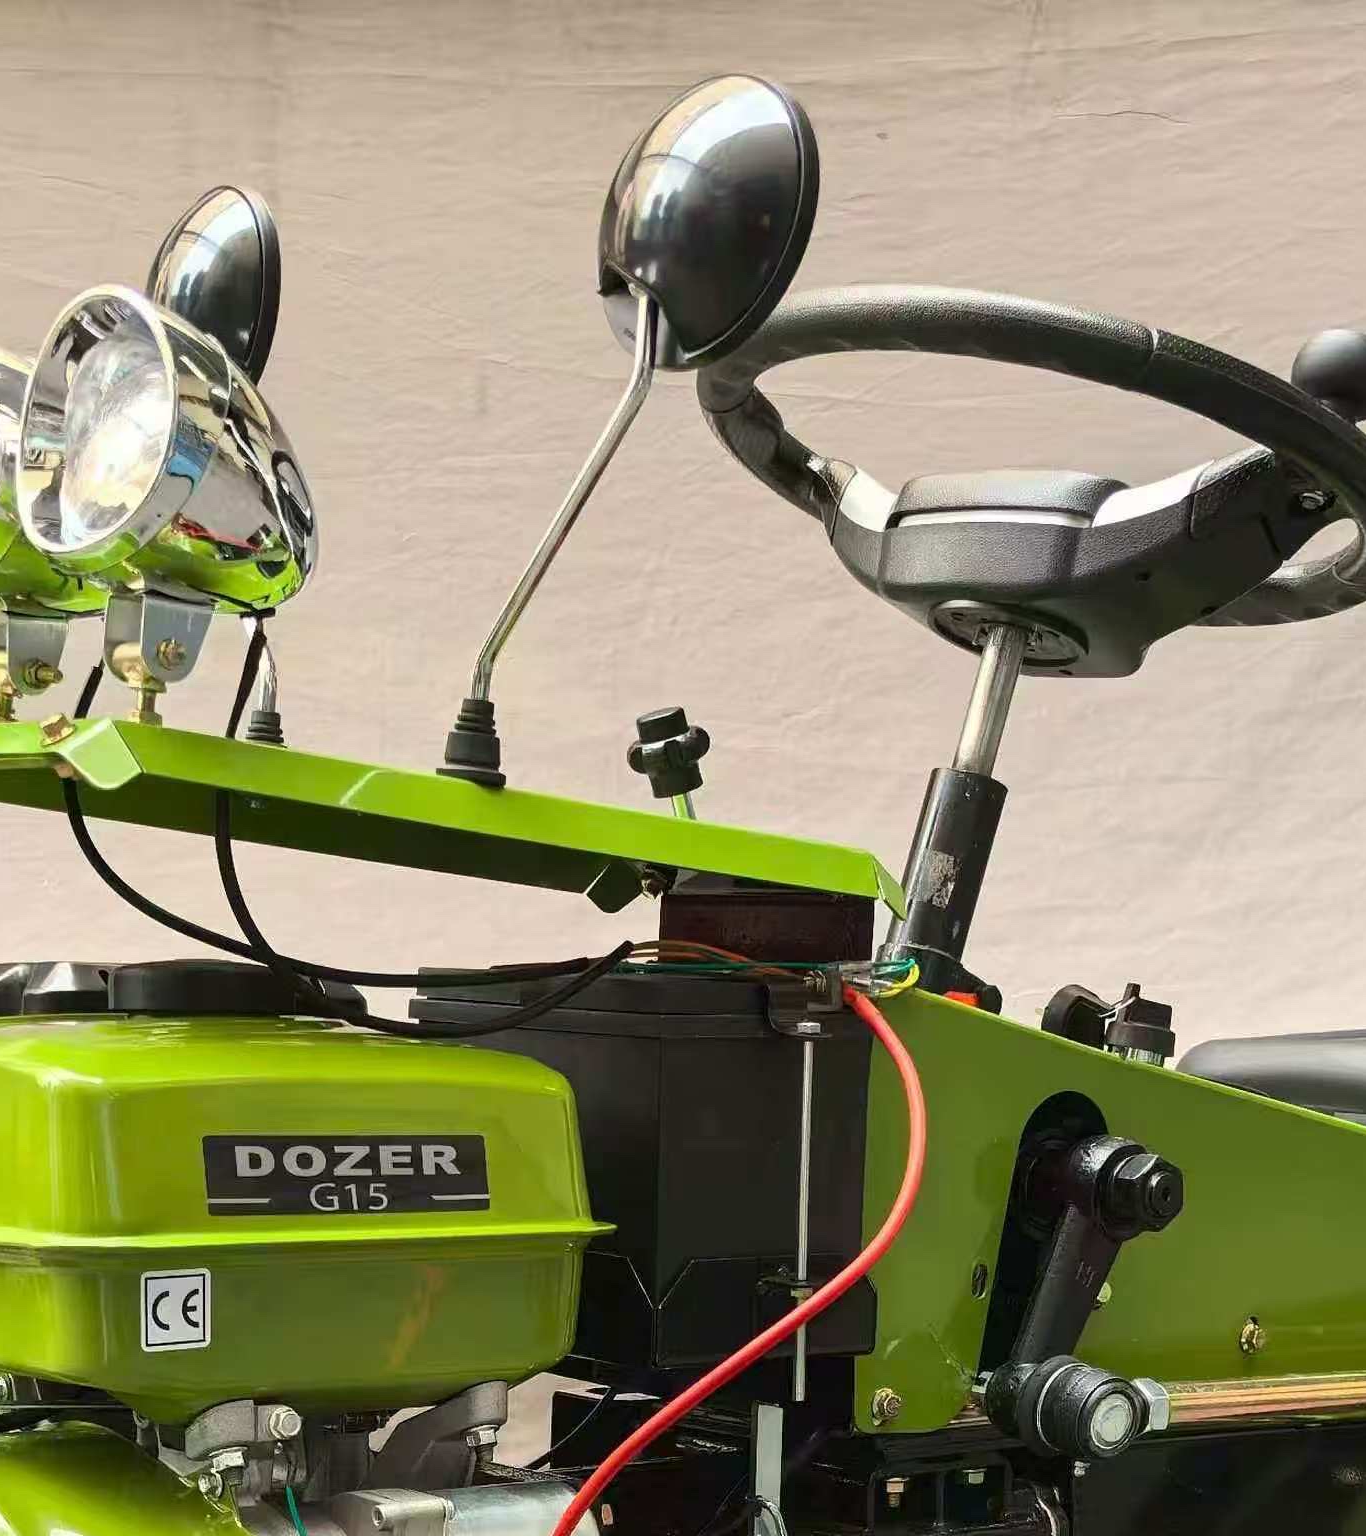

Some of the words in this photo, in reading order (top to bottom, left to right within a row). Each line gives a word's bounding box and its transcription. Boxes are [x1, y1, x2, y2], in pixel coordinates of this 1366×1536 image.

[234, 1144, 462, 1177] DOZER
[308, 1183, 389, 1212] G15
[152, 1288, 199, 1331] CE
